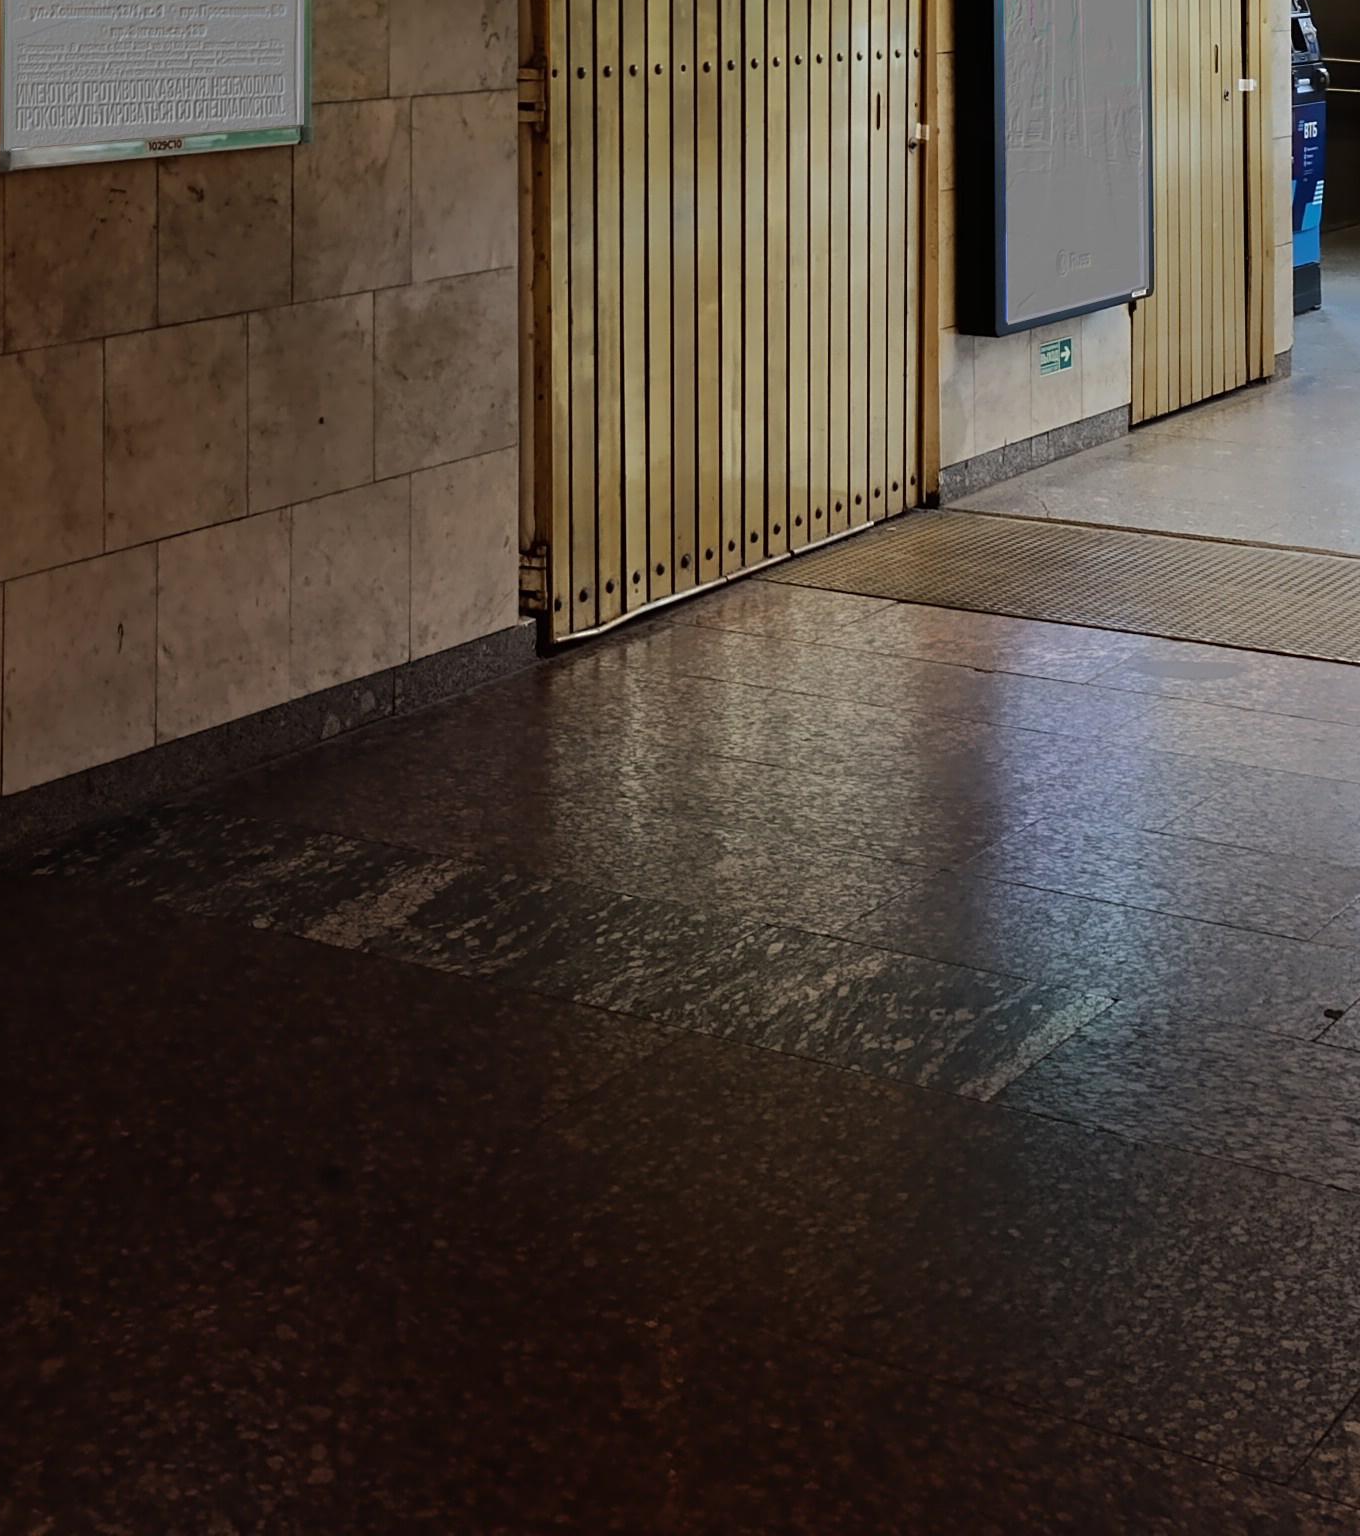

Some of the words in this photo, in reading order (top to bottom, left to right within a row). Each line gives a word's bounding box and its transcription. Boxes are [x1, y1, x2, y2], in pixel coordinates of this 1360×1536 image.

[17, 81, 80, 106] ИМЕЮТСЯ
[17, 100, 176, 131] ПРОКОНСУЛЬТИРОВАТЬСЯ
[177, 100, 192, 122] СО
[1304, 121, 1318, 139] ВТБ
